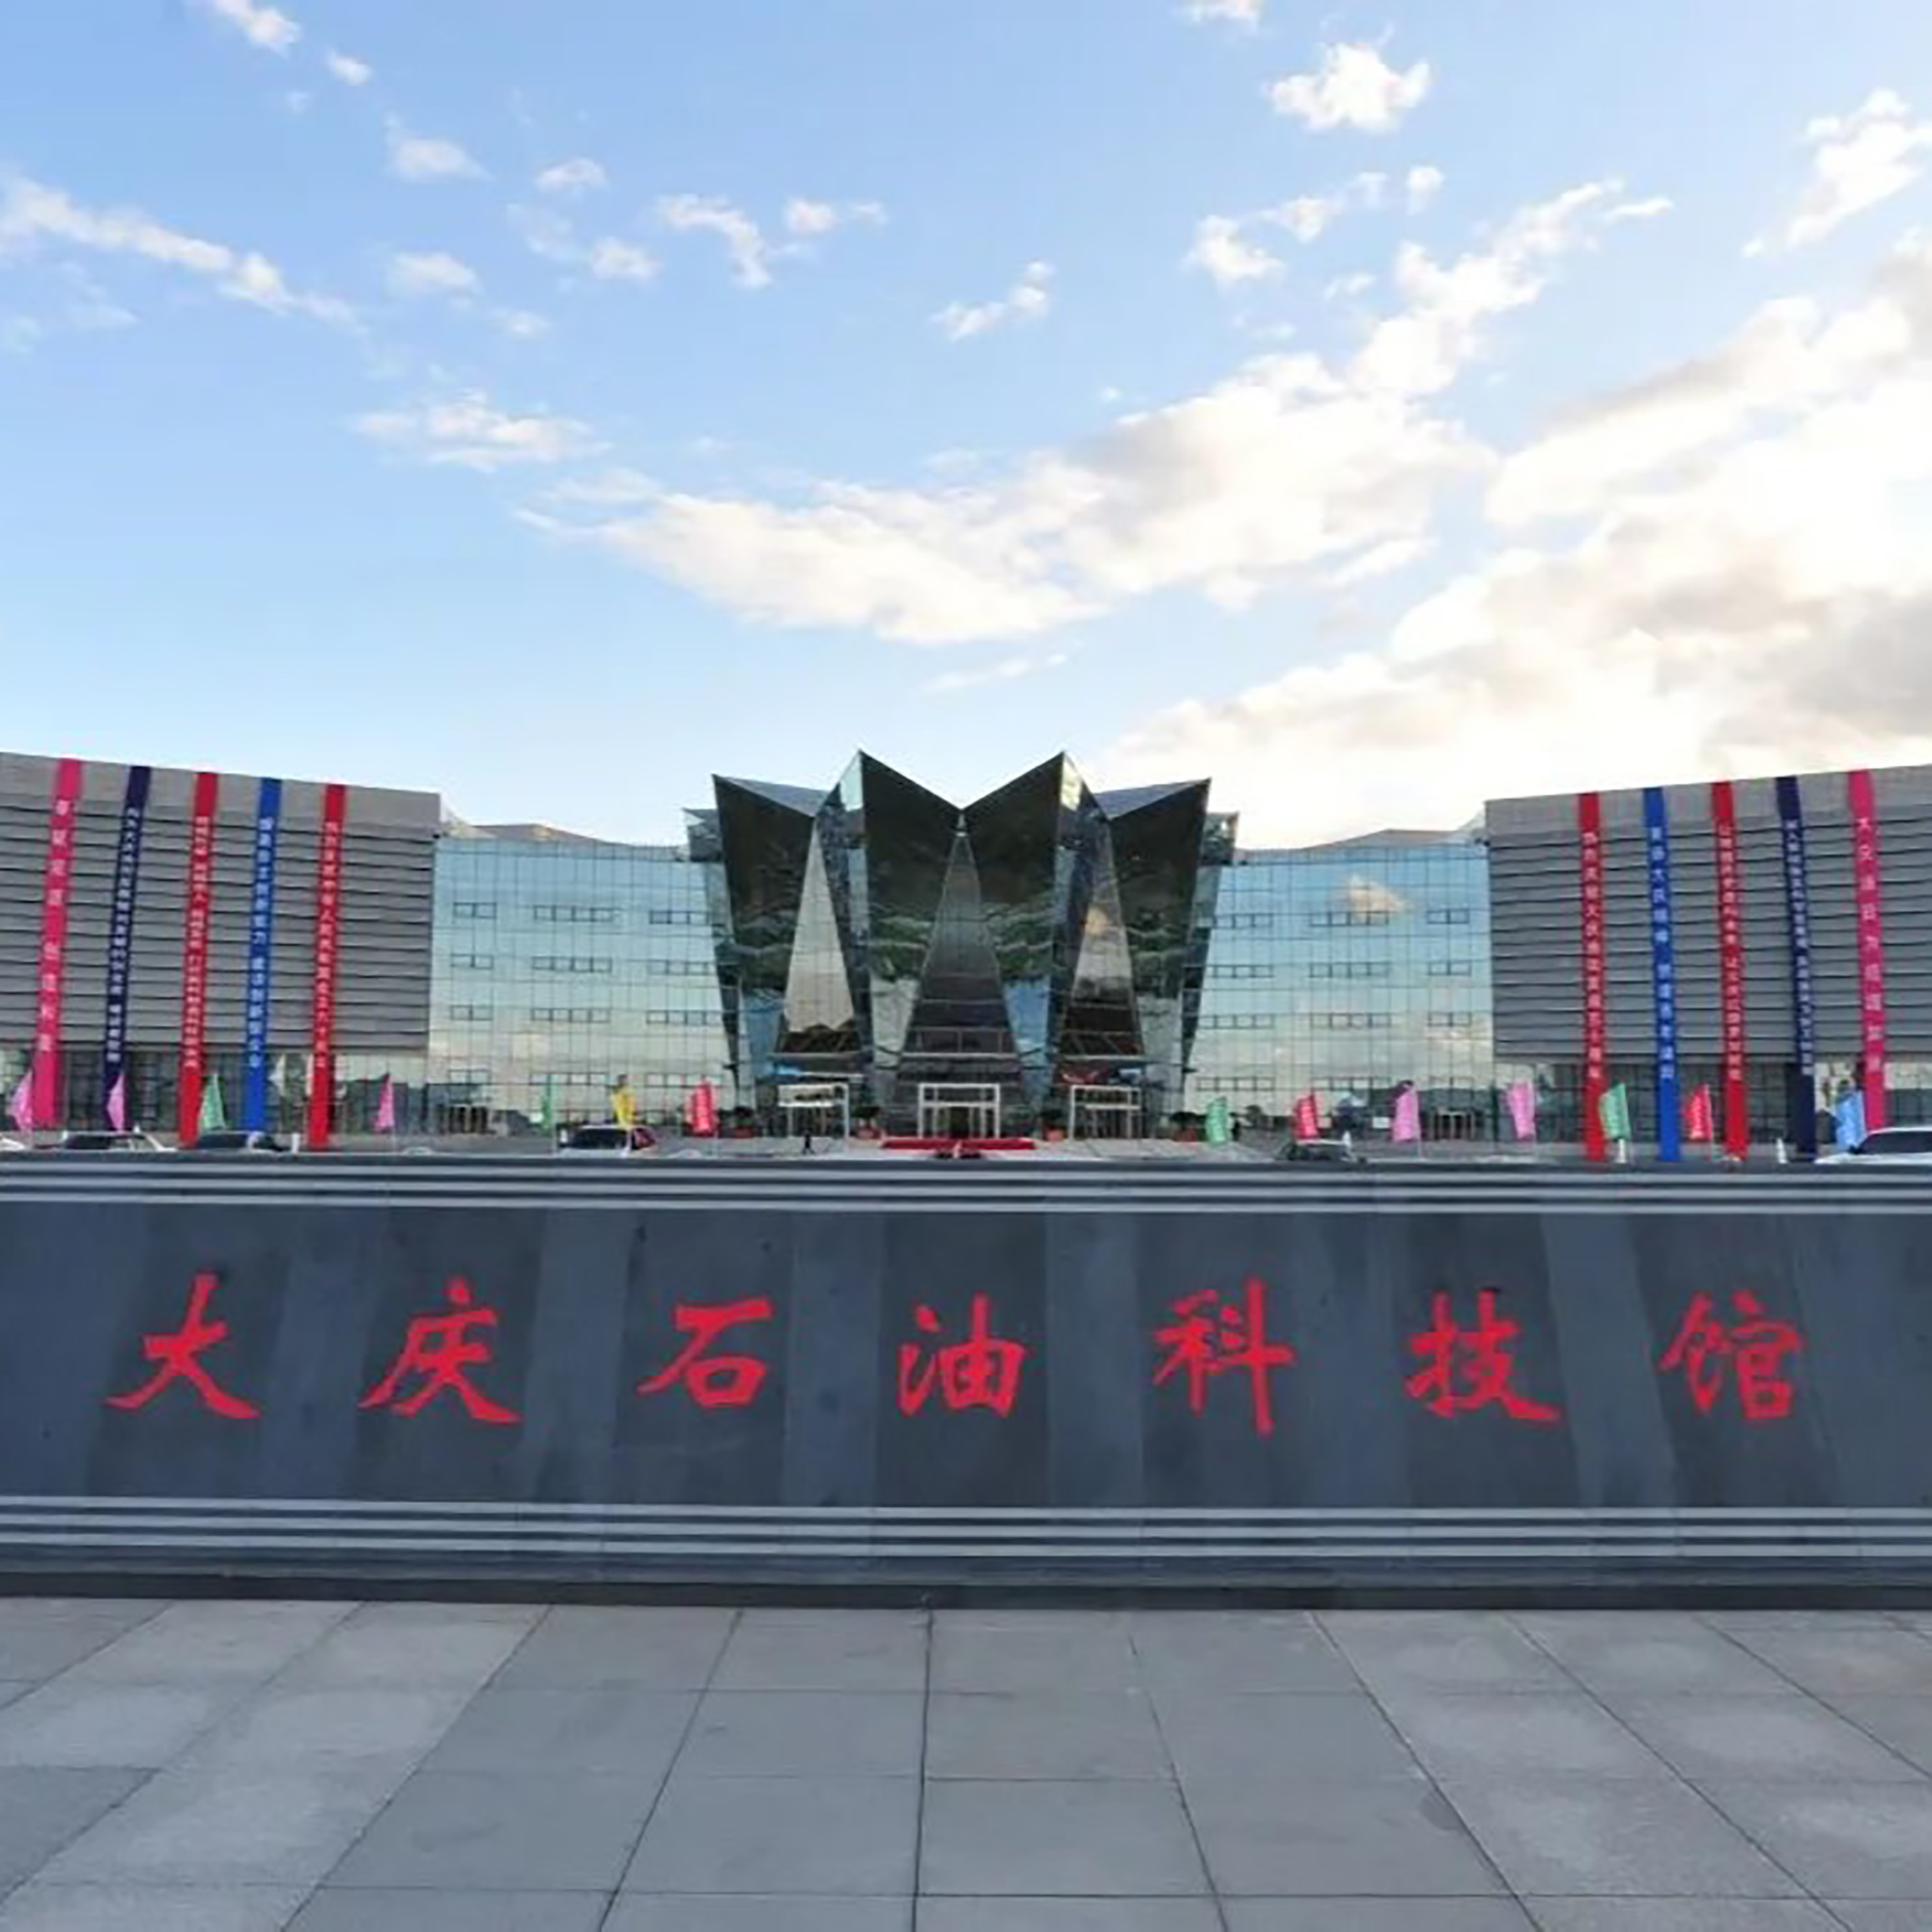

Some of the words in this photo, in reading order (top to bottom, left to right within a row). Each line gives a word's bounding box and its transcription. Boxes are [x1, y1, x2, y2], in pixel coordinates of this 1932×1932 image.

[107, 1274, 1804, 1435] 大庆石油科技馆
